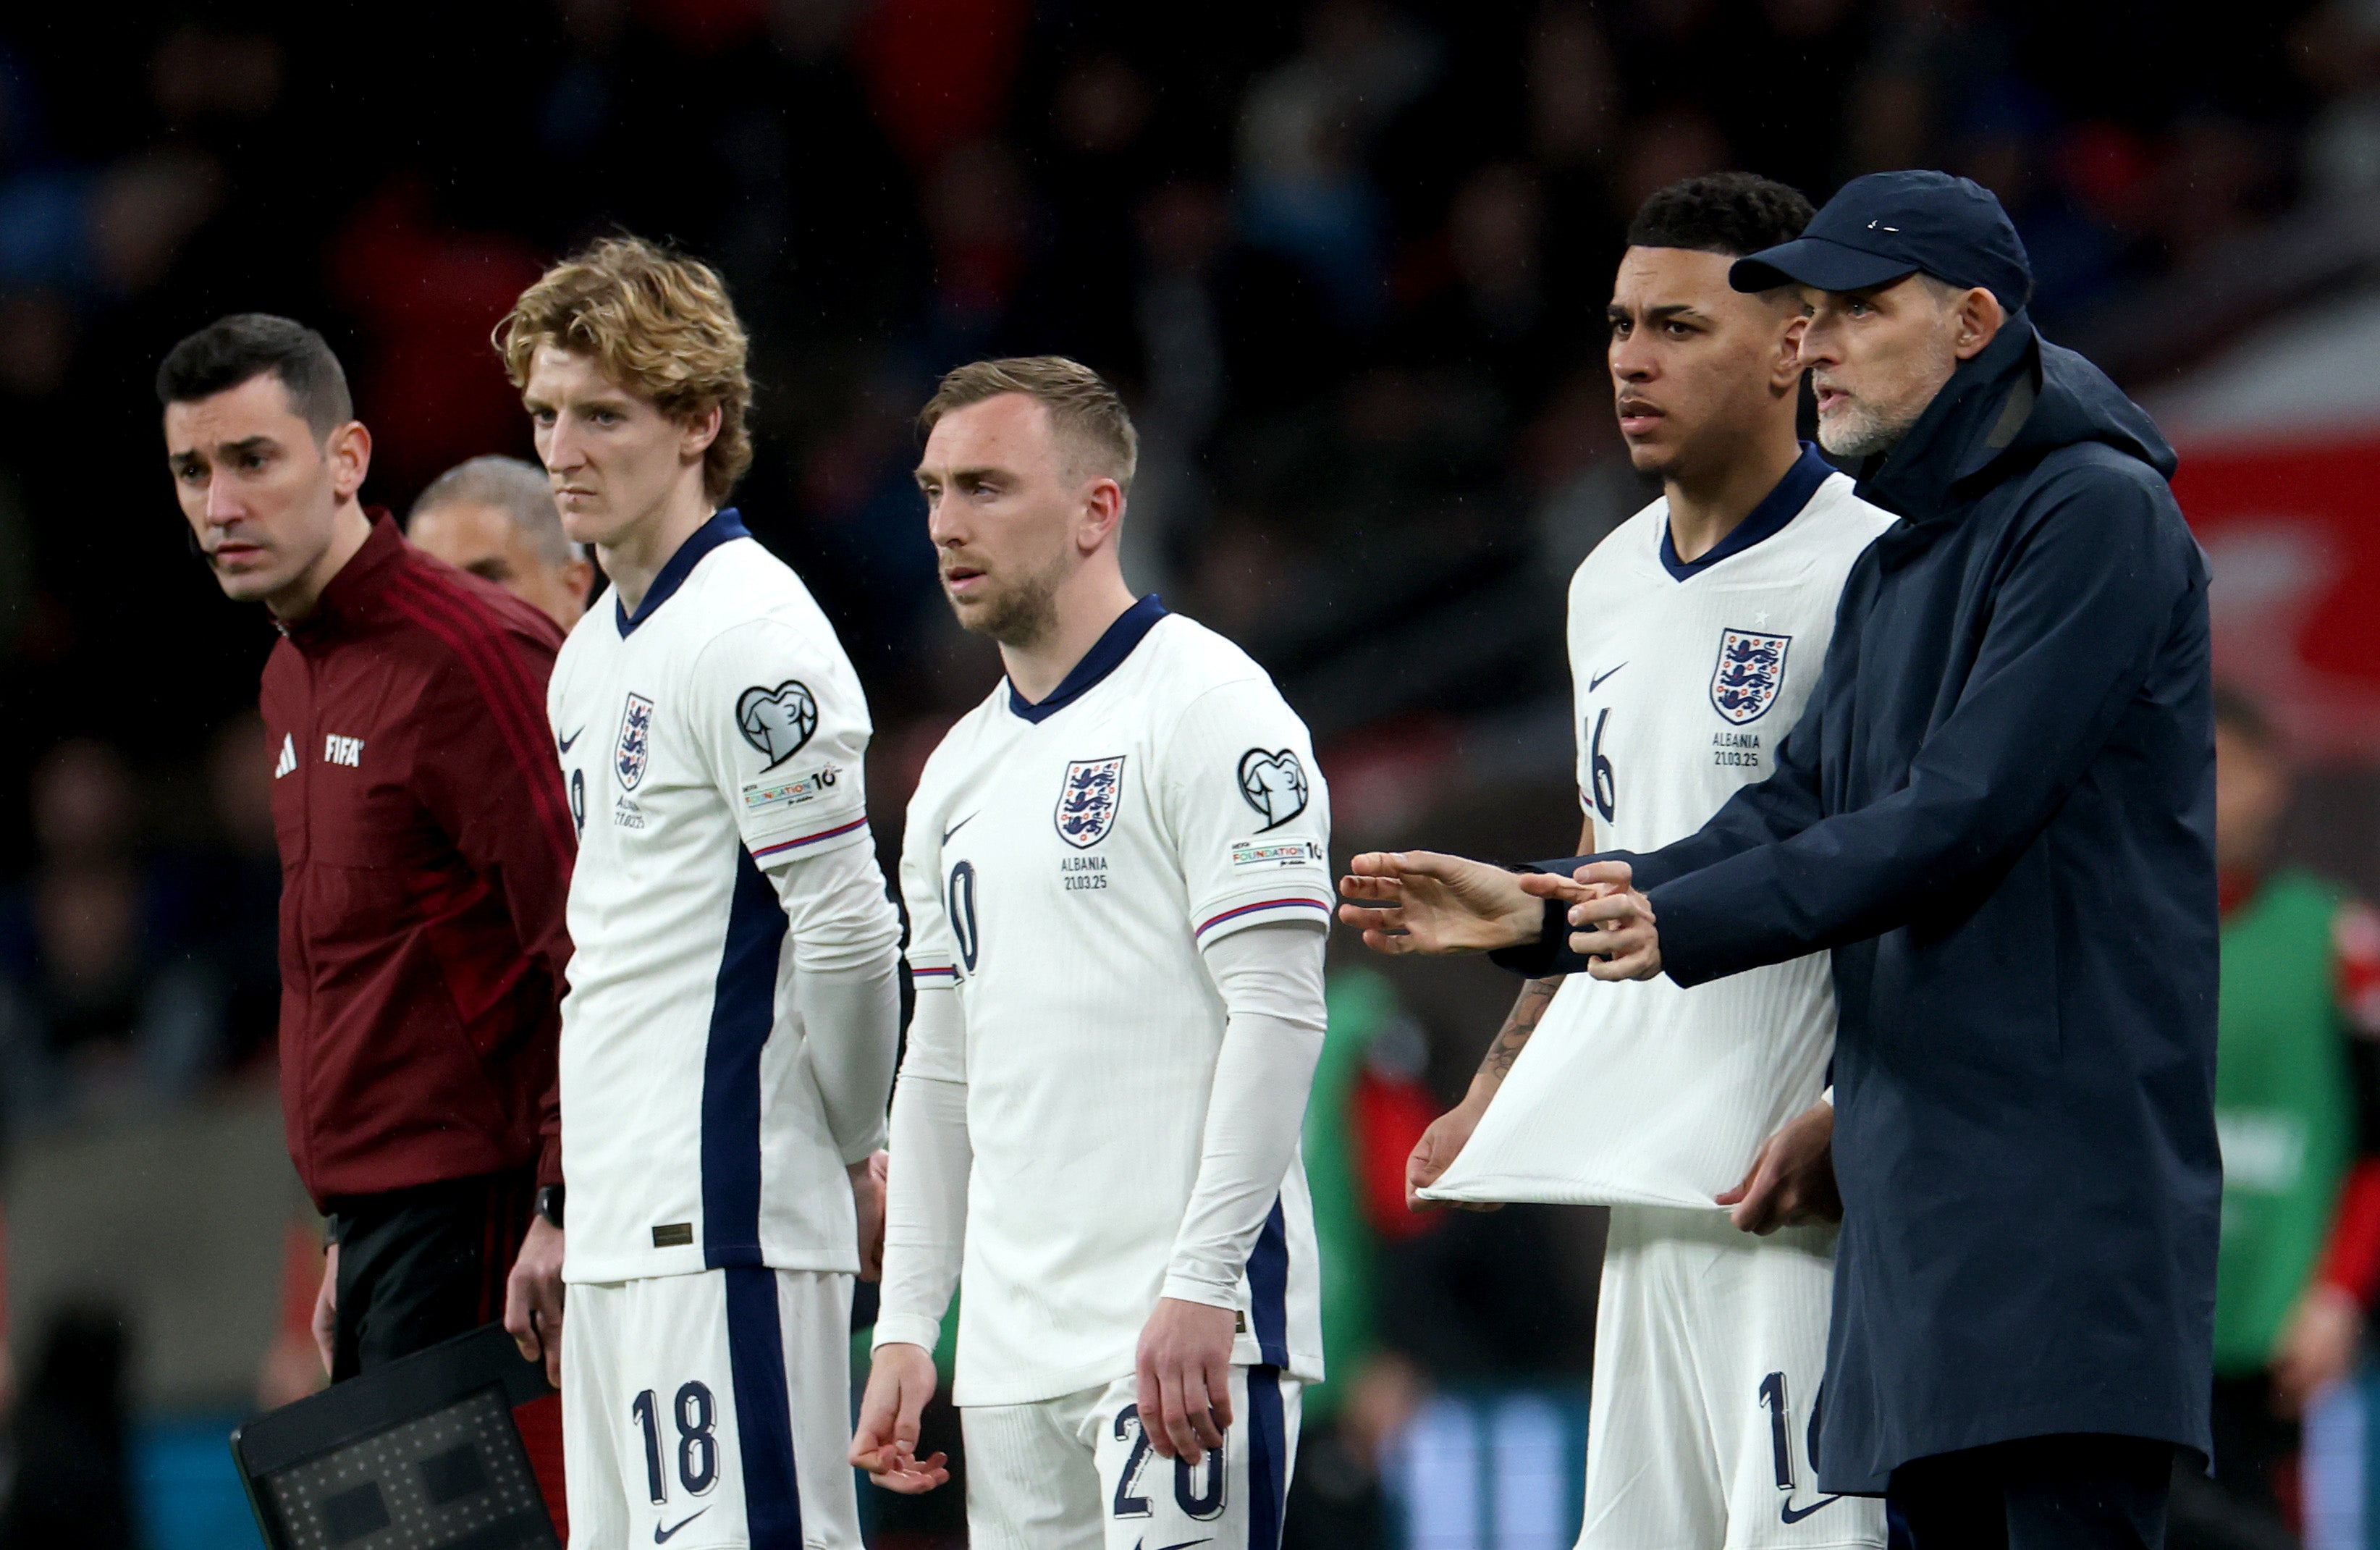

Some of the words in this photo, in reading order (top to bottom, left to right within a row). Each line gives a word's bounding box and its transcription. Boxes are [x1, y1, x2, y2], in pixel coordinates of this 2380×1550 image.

[1713, 733, 1760, 749] ALBANIA
[324, 733, 360, 767] FIFA
[1715, 751, 1758, 767] 21.03.25
[1233, 847, 1305, 862] FOUNDATION
[1061, 856, 1108, 872] ALBANIA
[1064, 875, 1107, 890] 21.03.25
[1759, 1371, 1823, 1490] 1
[633, 1380, 720, 1505] 18
[1114, 1403, 1229, 1522] 20
